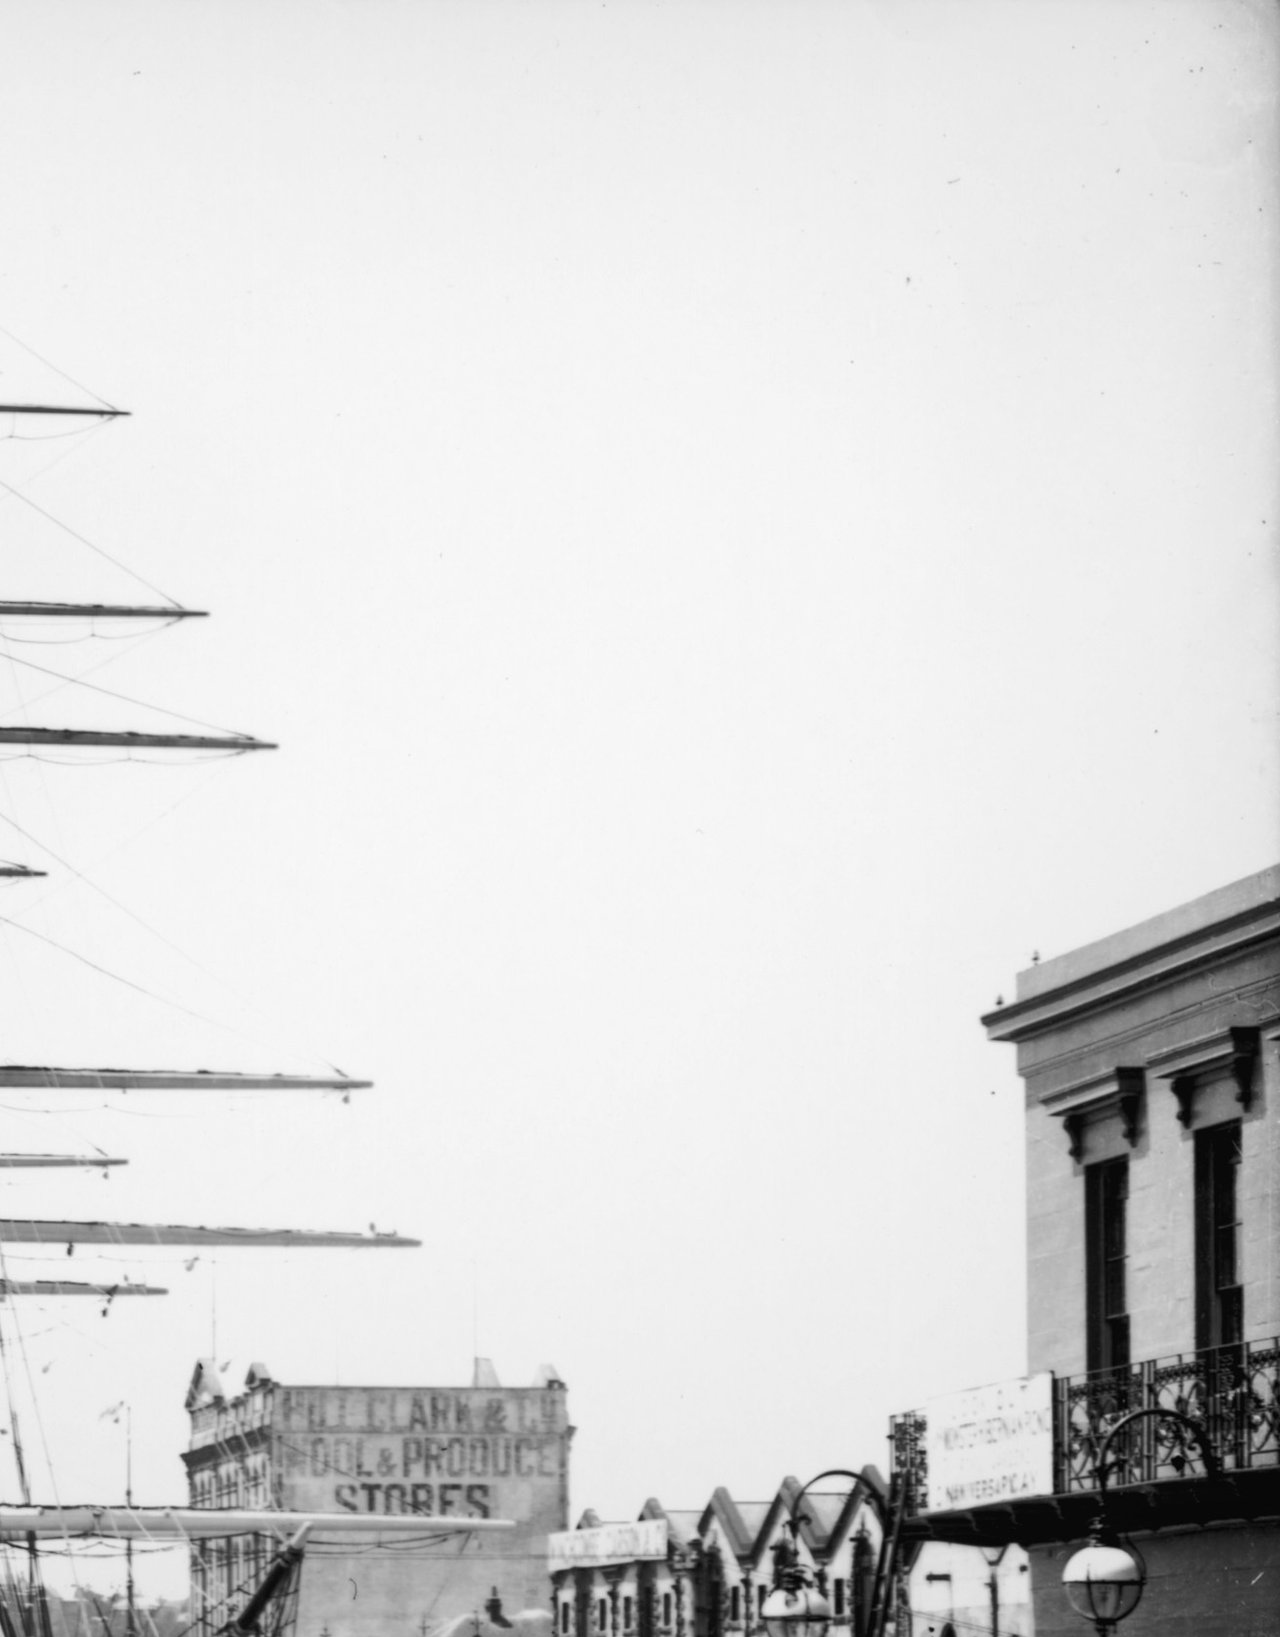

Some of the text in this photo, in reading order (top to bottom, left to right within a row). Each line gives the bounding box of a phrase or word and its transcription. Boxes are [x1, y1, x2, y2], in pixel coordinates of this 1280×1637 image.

[483, 1398, 506, 1431] &
[377, 1447, 398, 1478] &
[402, 1437, 559, 1478] PRODUCE
